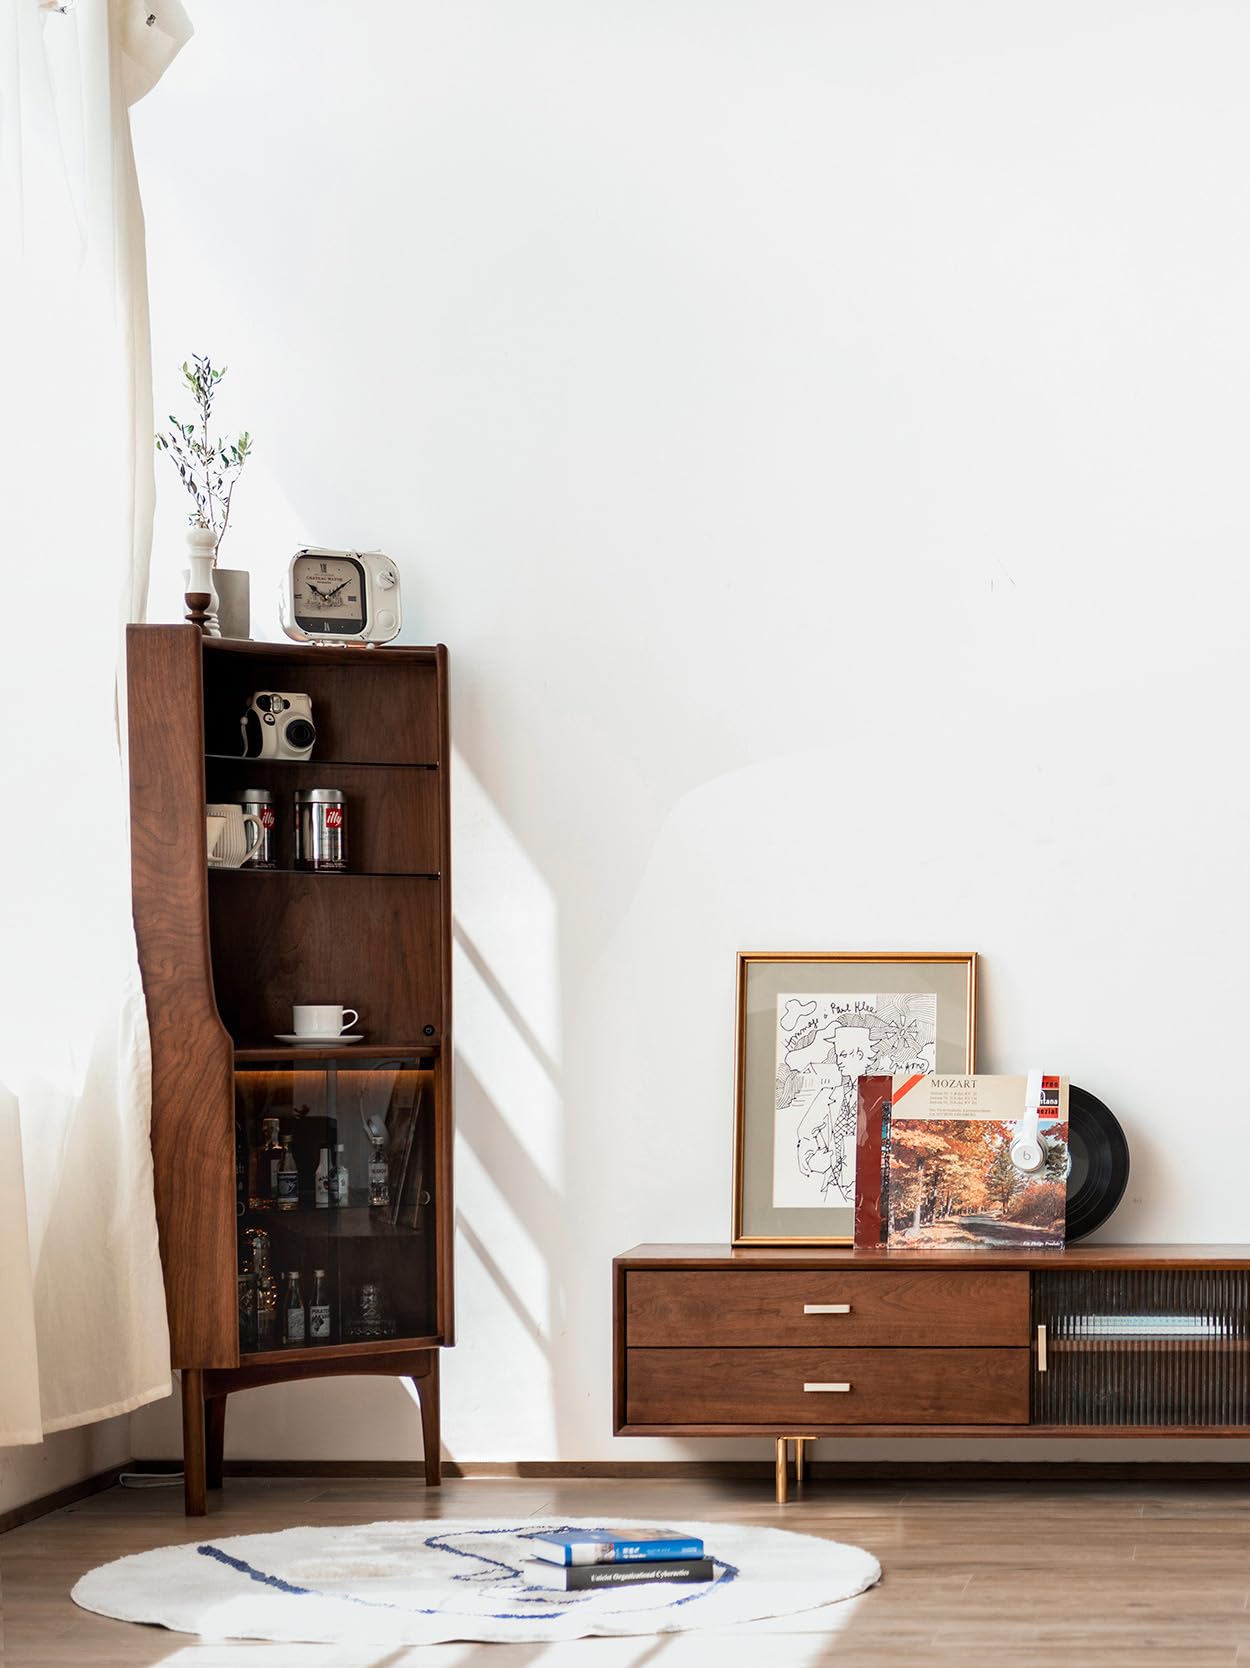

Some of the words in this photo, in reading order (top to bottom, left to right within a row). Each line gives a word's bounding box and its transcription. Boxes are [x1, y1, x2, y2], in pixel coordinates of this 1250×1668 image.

[262, 811, 275, 827] illy
[326, 810, 342, 827] illy
[830, 1002, 851, 1014] Paul
[931, 1079, 978, 1089] MOZART
